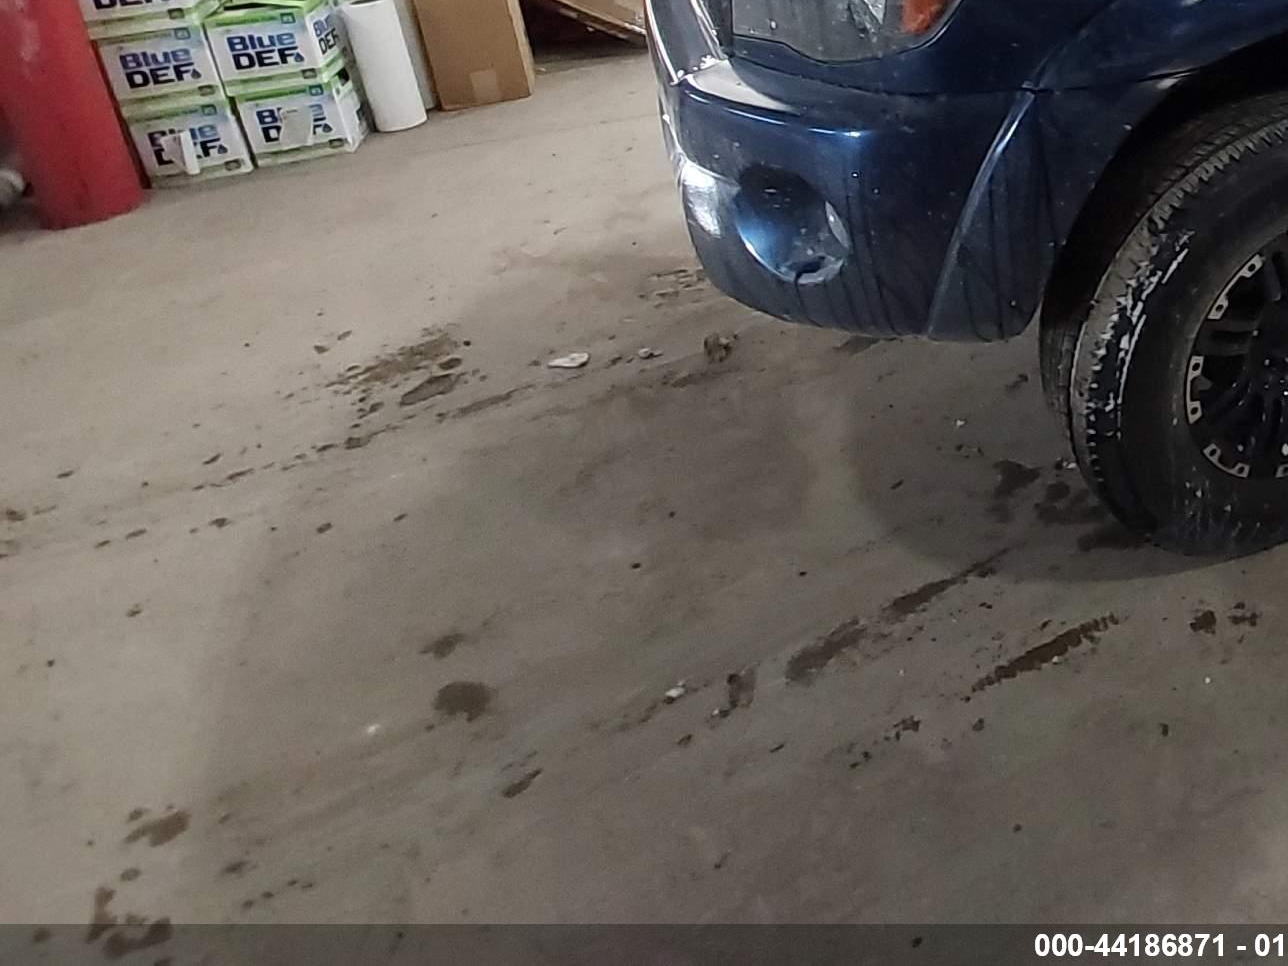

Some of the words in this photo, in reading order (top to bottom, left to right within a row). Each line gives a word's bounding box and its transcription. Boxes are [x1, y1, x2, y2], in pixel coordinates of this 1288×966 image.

[227, 33, 296, 53] Blue
[119, 49, 193, 70] Blue
[232, 46, 299, 70] DEF
[125, 62, 195, 89] DEF
